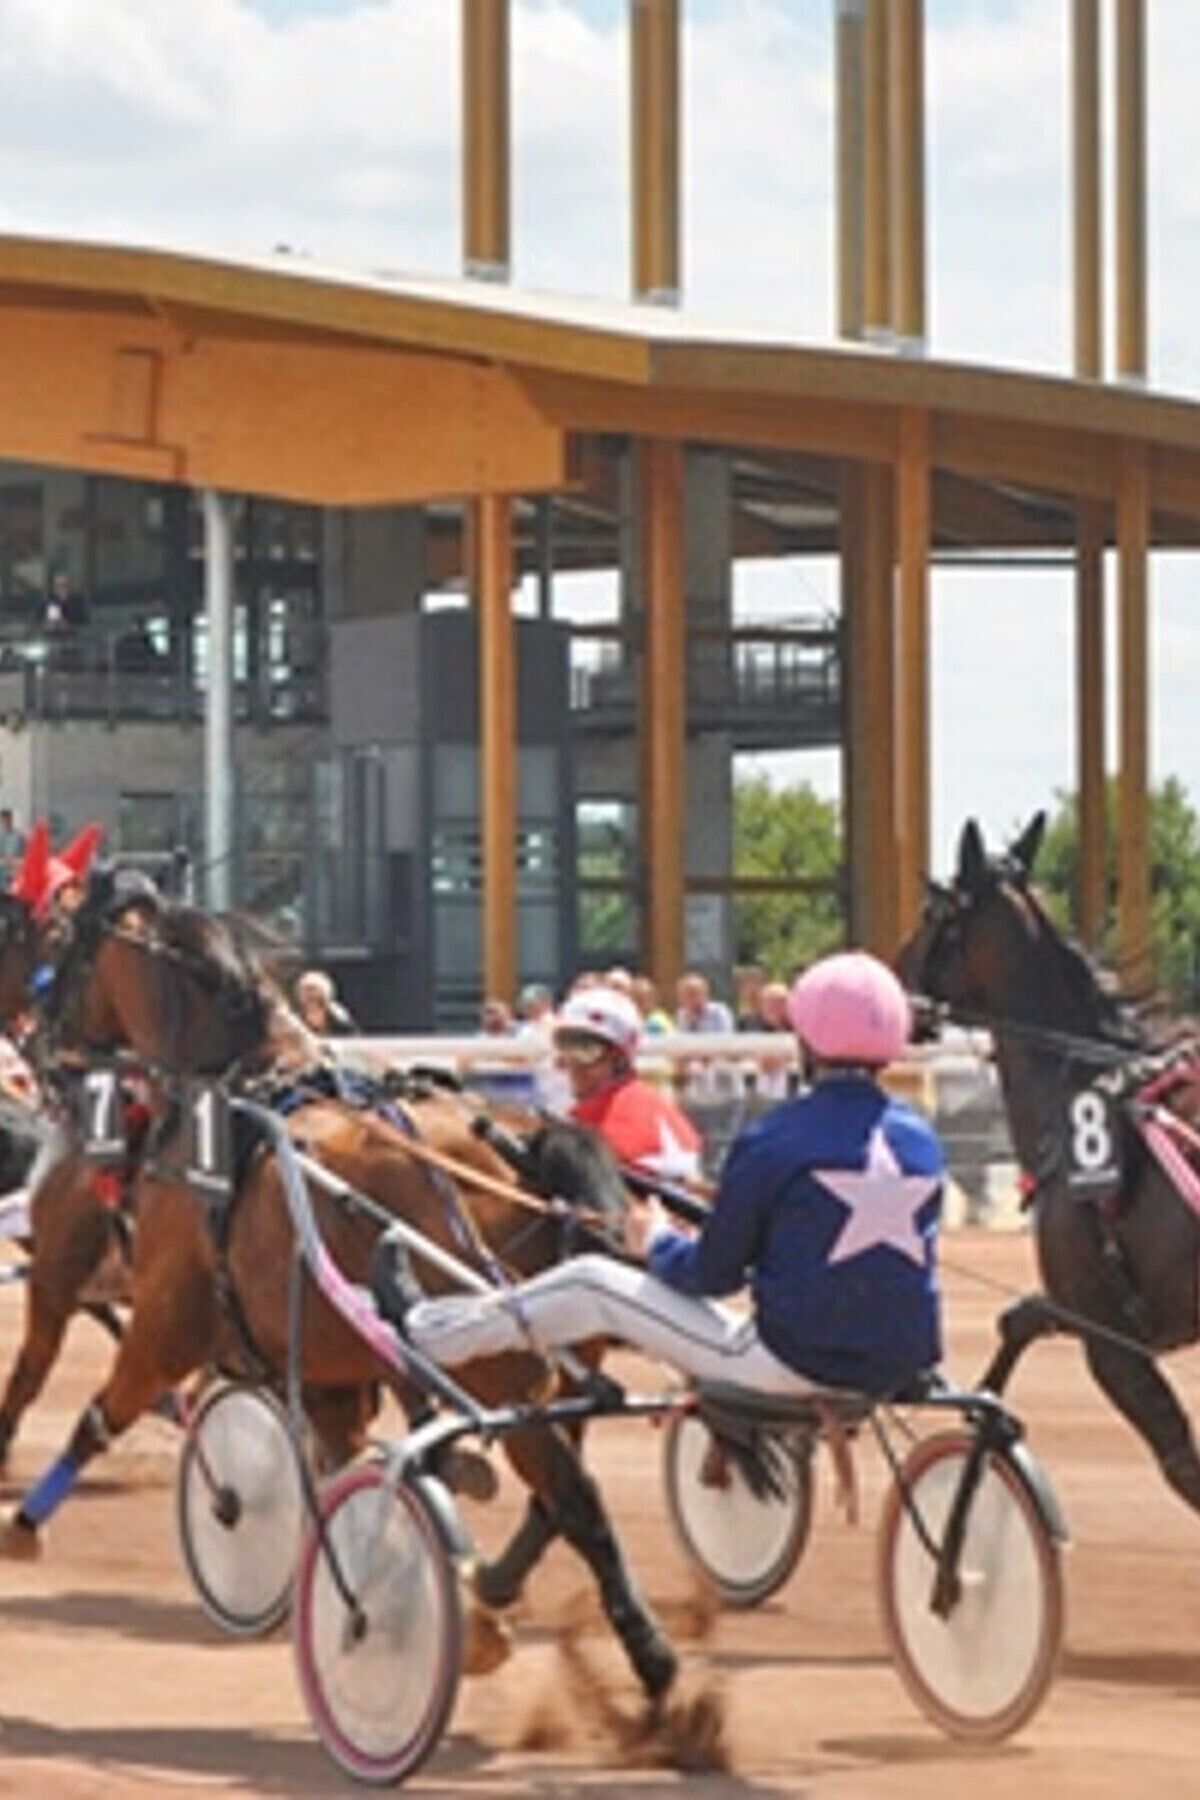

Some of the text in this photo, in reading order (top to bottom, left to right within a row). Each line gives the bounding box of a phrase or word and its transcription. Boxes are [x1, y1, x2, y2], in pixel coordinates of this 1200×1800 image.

[85, 1072, 115, 1139] 7
[195, 1090, 212, 1170] 1
[1072, 1090, 1110, 1168] 8
